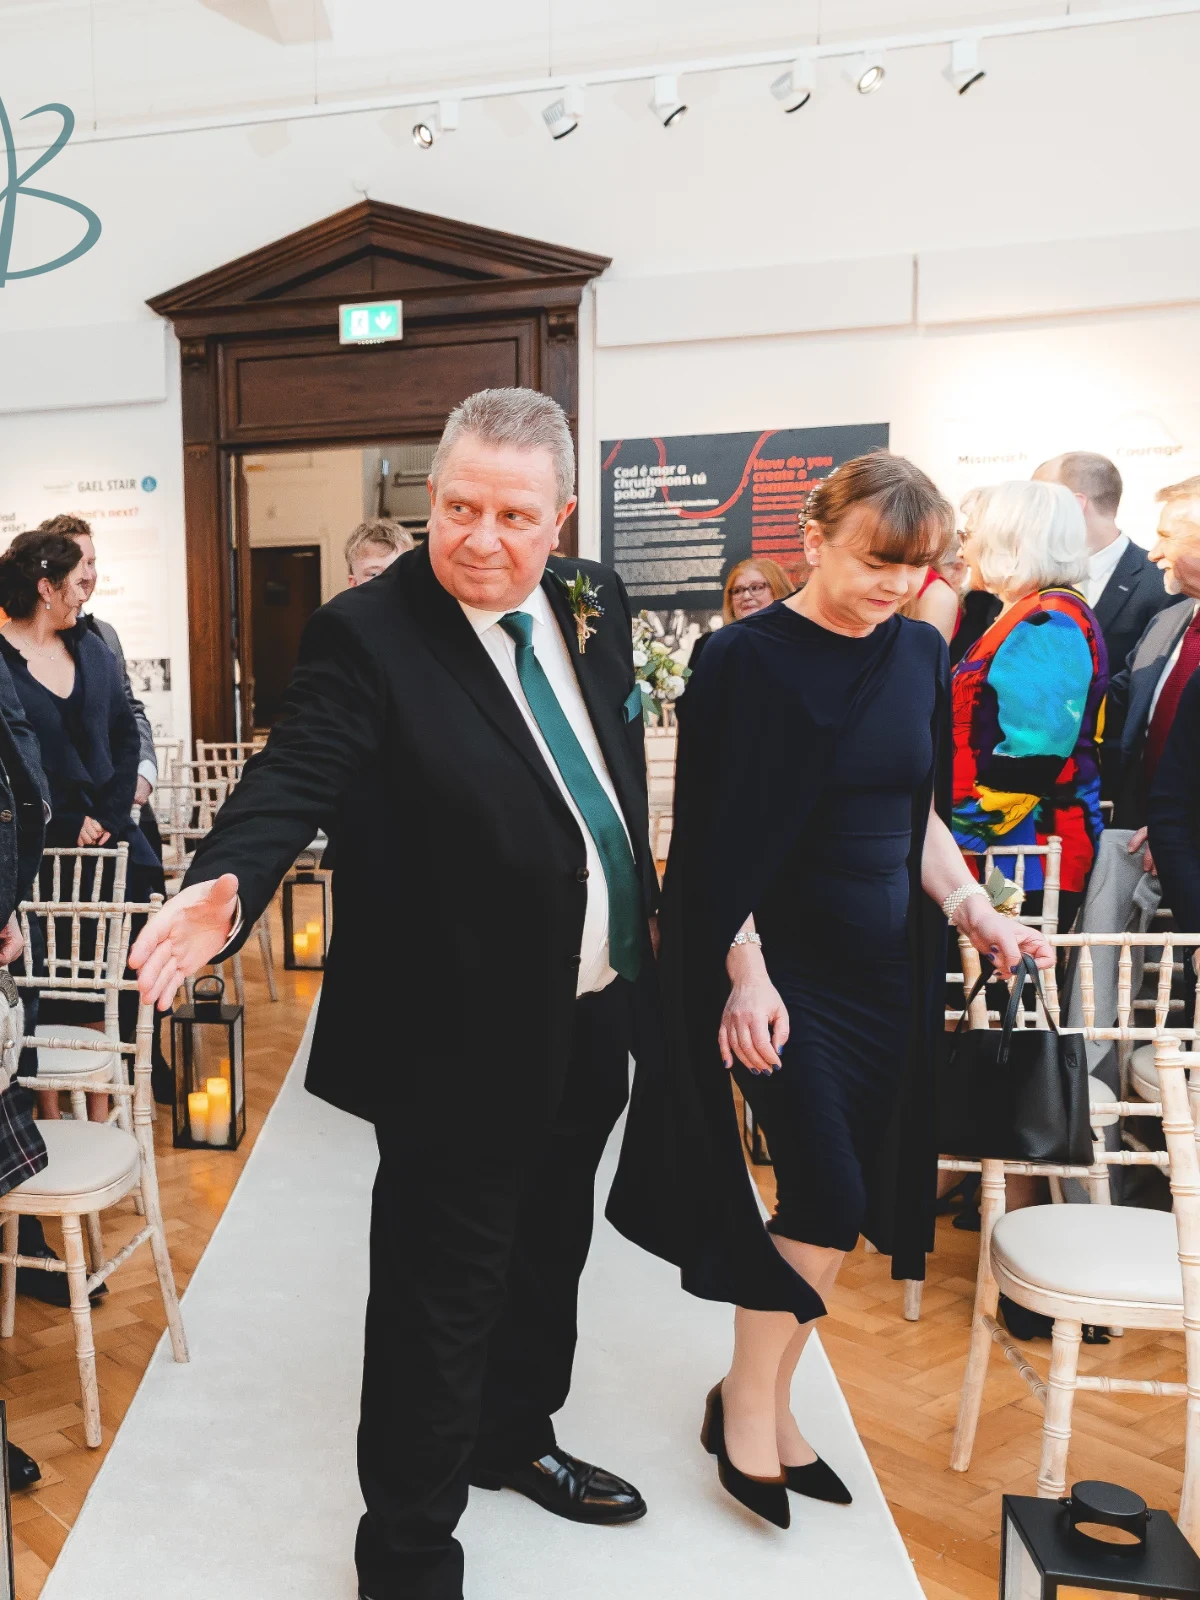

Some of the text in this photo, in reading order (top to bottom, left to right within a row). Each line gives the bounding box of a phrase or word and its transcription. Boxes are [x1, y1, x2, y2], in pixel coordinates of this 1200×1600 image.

[1116, 444, 1184, 457] Courage
[752, 455, 833, 471] How do you
[957, 452, 1028, 465] Misneach
[614, 464, 687, 478] Cad é mar a
[752, 468, 808, 483] create a
[692, 472, 707, 485] tú
[78, 481, 104, 492] GAEL
[107, 479, 137, 491] STAIR
[614, 486, 657, 502] pobal?
